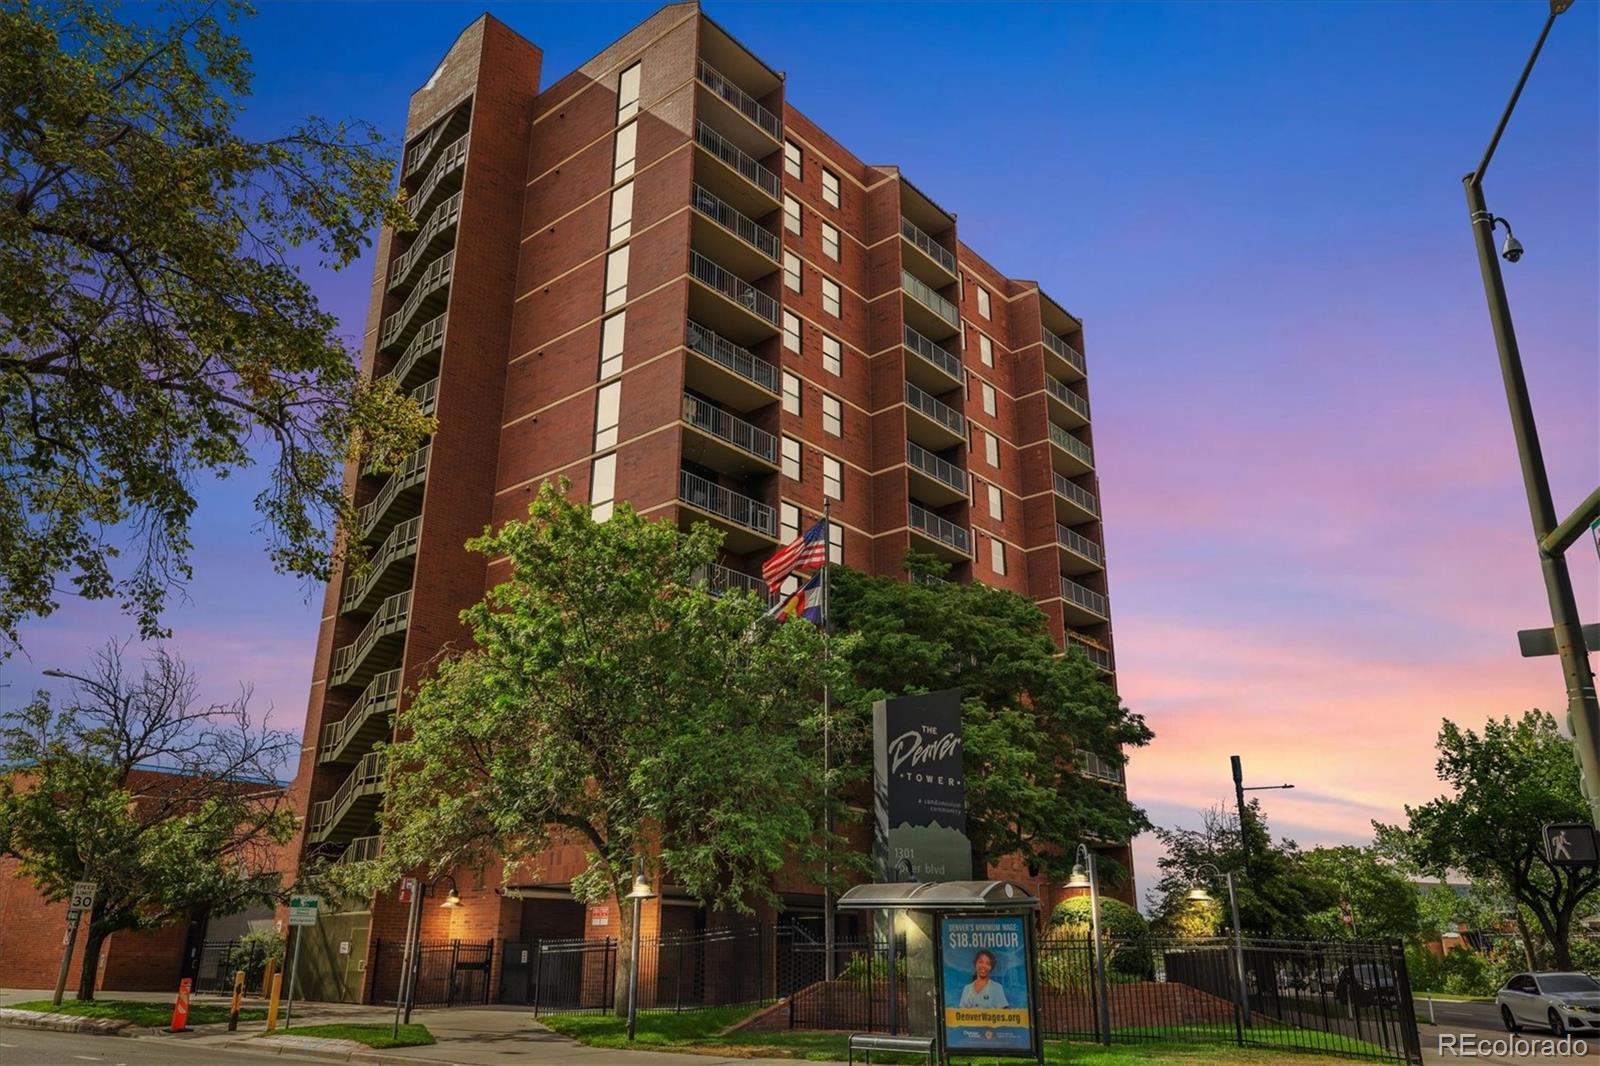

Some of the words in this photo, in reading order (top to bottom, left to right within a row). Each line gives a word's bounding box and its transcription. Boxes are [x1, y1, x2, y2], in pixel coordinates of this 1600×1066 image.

[922, 725, 937, 735] THE
[888, 730, 962, 774] Denver
[906, 772, 954, 786] TOWER
[894, 847, 914, 859] 1301
[925, 863, 945, 875] blvd
[76, 883, 95, 891] SPEED
[72, 896, 92, 907] 30
[948, 923, 975, 932] DENVER'S
[949, 932, 1019, 949] $18.81/HOUR
[956, 1012, 1021, 1024] DenverWages.org
